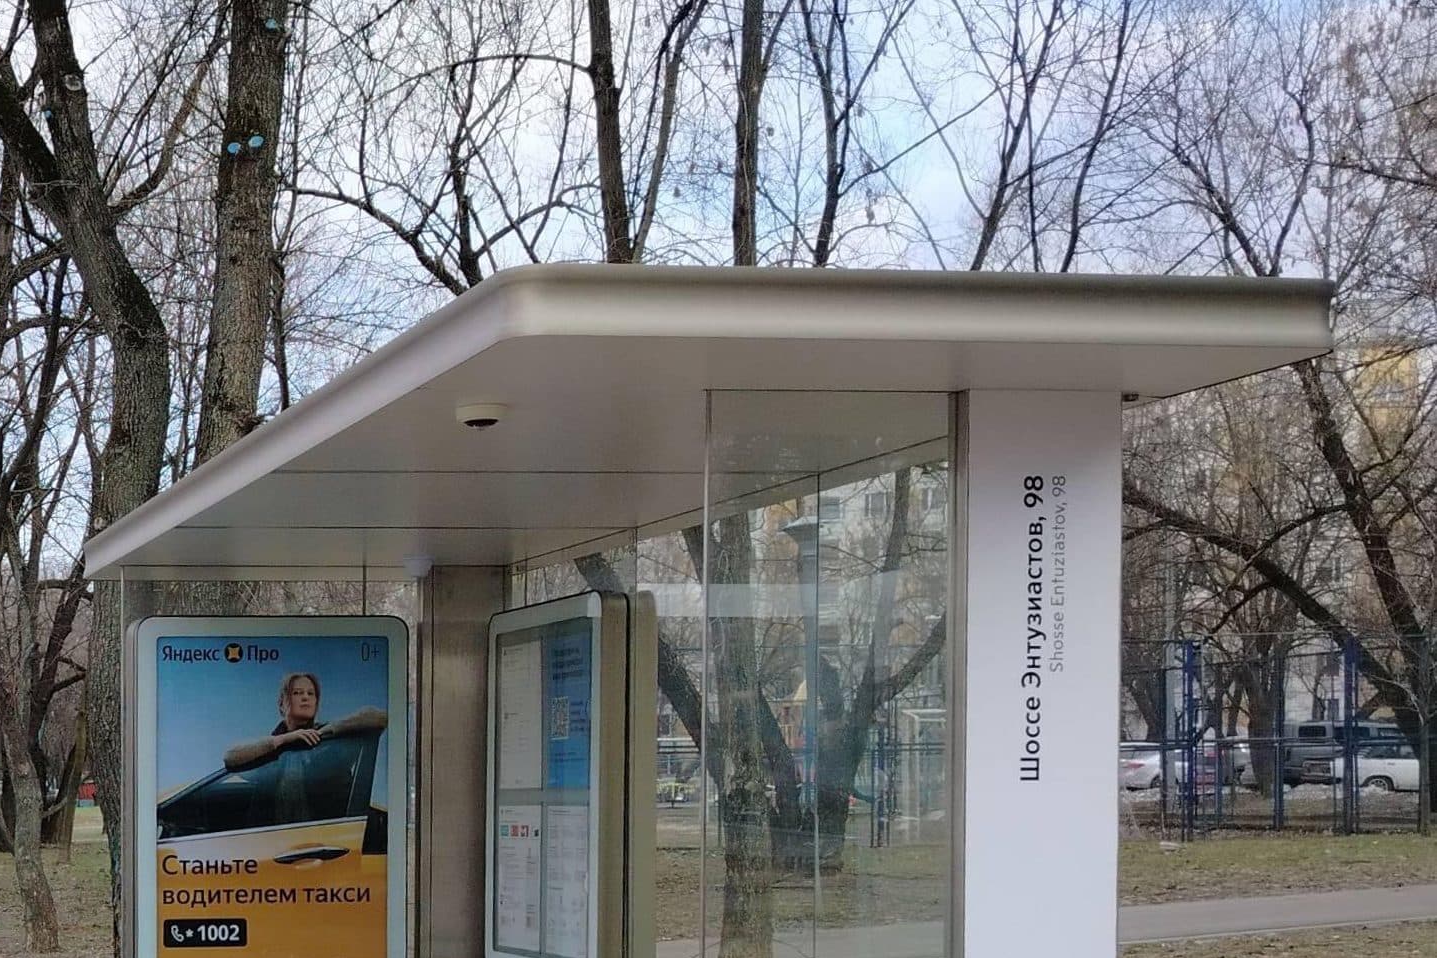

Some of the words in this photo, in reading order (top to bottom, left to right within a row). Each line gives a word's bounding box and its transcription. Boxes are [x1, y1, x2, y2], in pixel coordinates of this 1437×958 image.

[1023, 475, 1044, 508] 98
[1052, 475, 1066, 497] 98
[1050, 501, 1067, 607] Entuziastov,
[1021, 515, 1047, 688] Энтузиастов,
[162, 645, 220, 664] Яндекс
[247, 645, 279, 664] Про
[361, 643, 380, 661] 0+
[1050, 611, 1064, 672] Shosse
[1020, 696, 1040, 781] Шоссе
[162, 855, 258, 875] Станьте
[162, 887, 297, 908] водителем
[302, 886, 371, 903] такси
